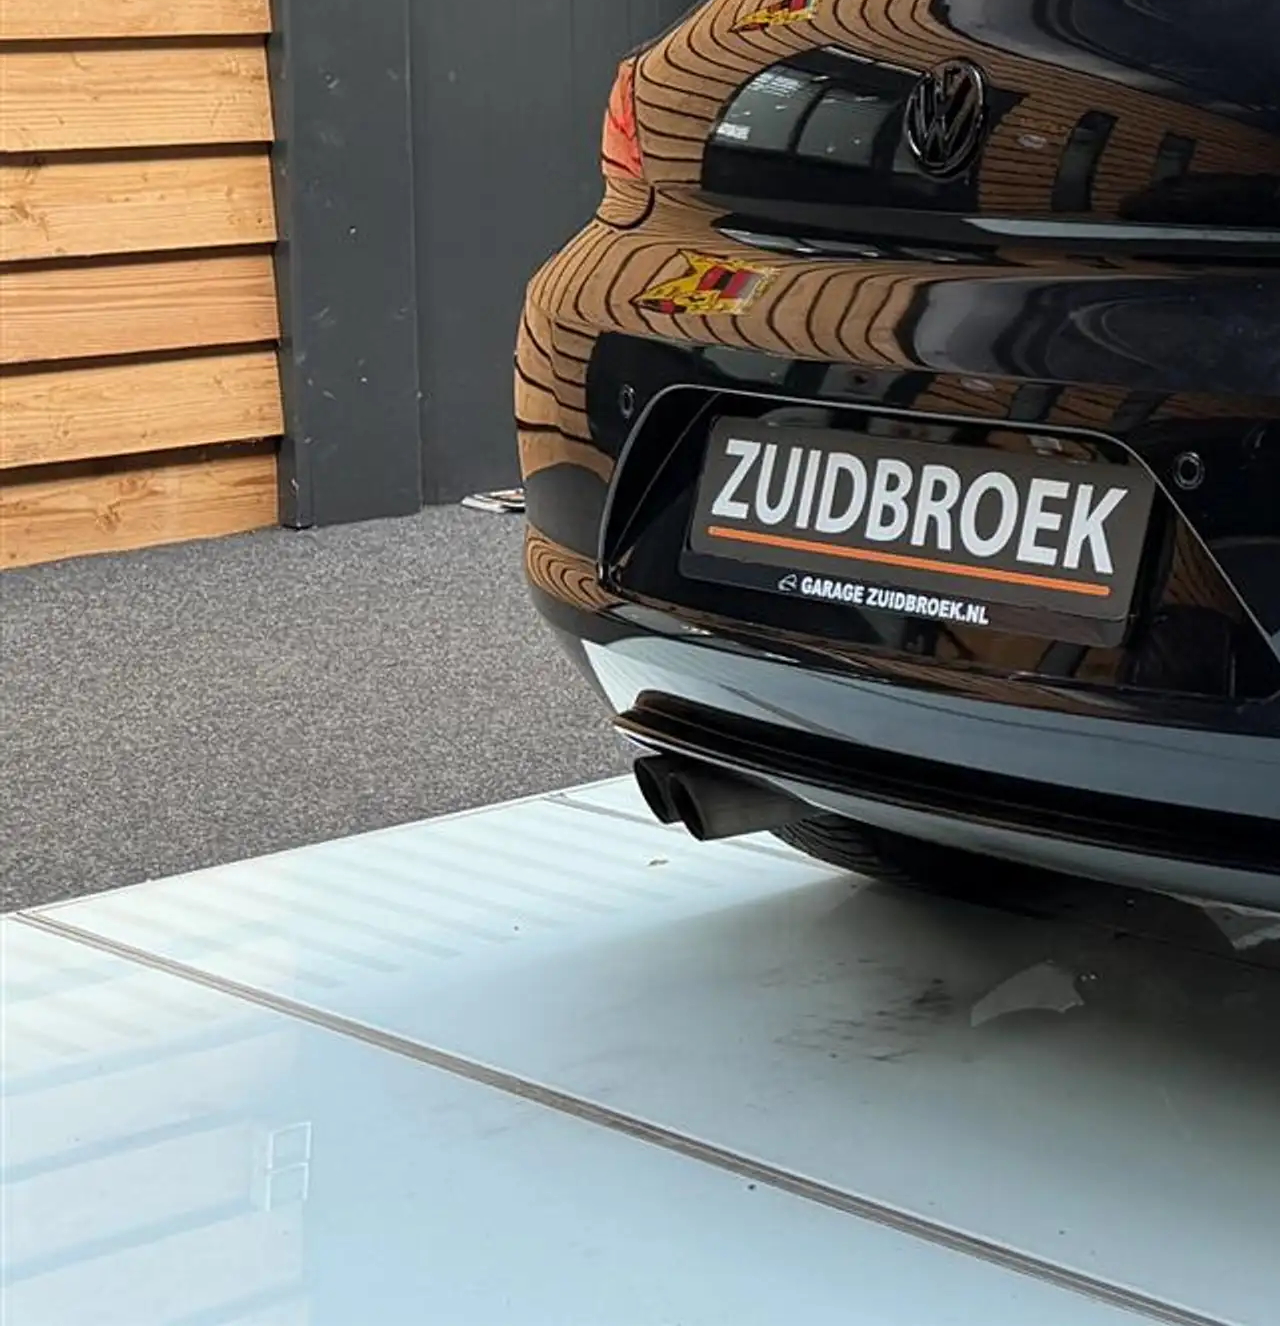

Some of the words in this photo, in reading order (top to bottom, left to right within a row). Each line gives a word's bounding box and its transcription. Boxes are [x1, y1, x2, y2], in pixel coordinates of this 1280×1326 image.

[711, 439, 1128, 575] ZUIDBROEK
[801, 575, 865, 604] GARAGE
[866, 587, 989, 625] ZUIDBROEK.NL
